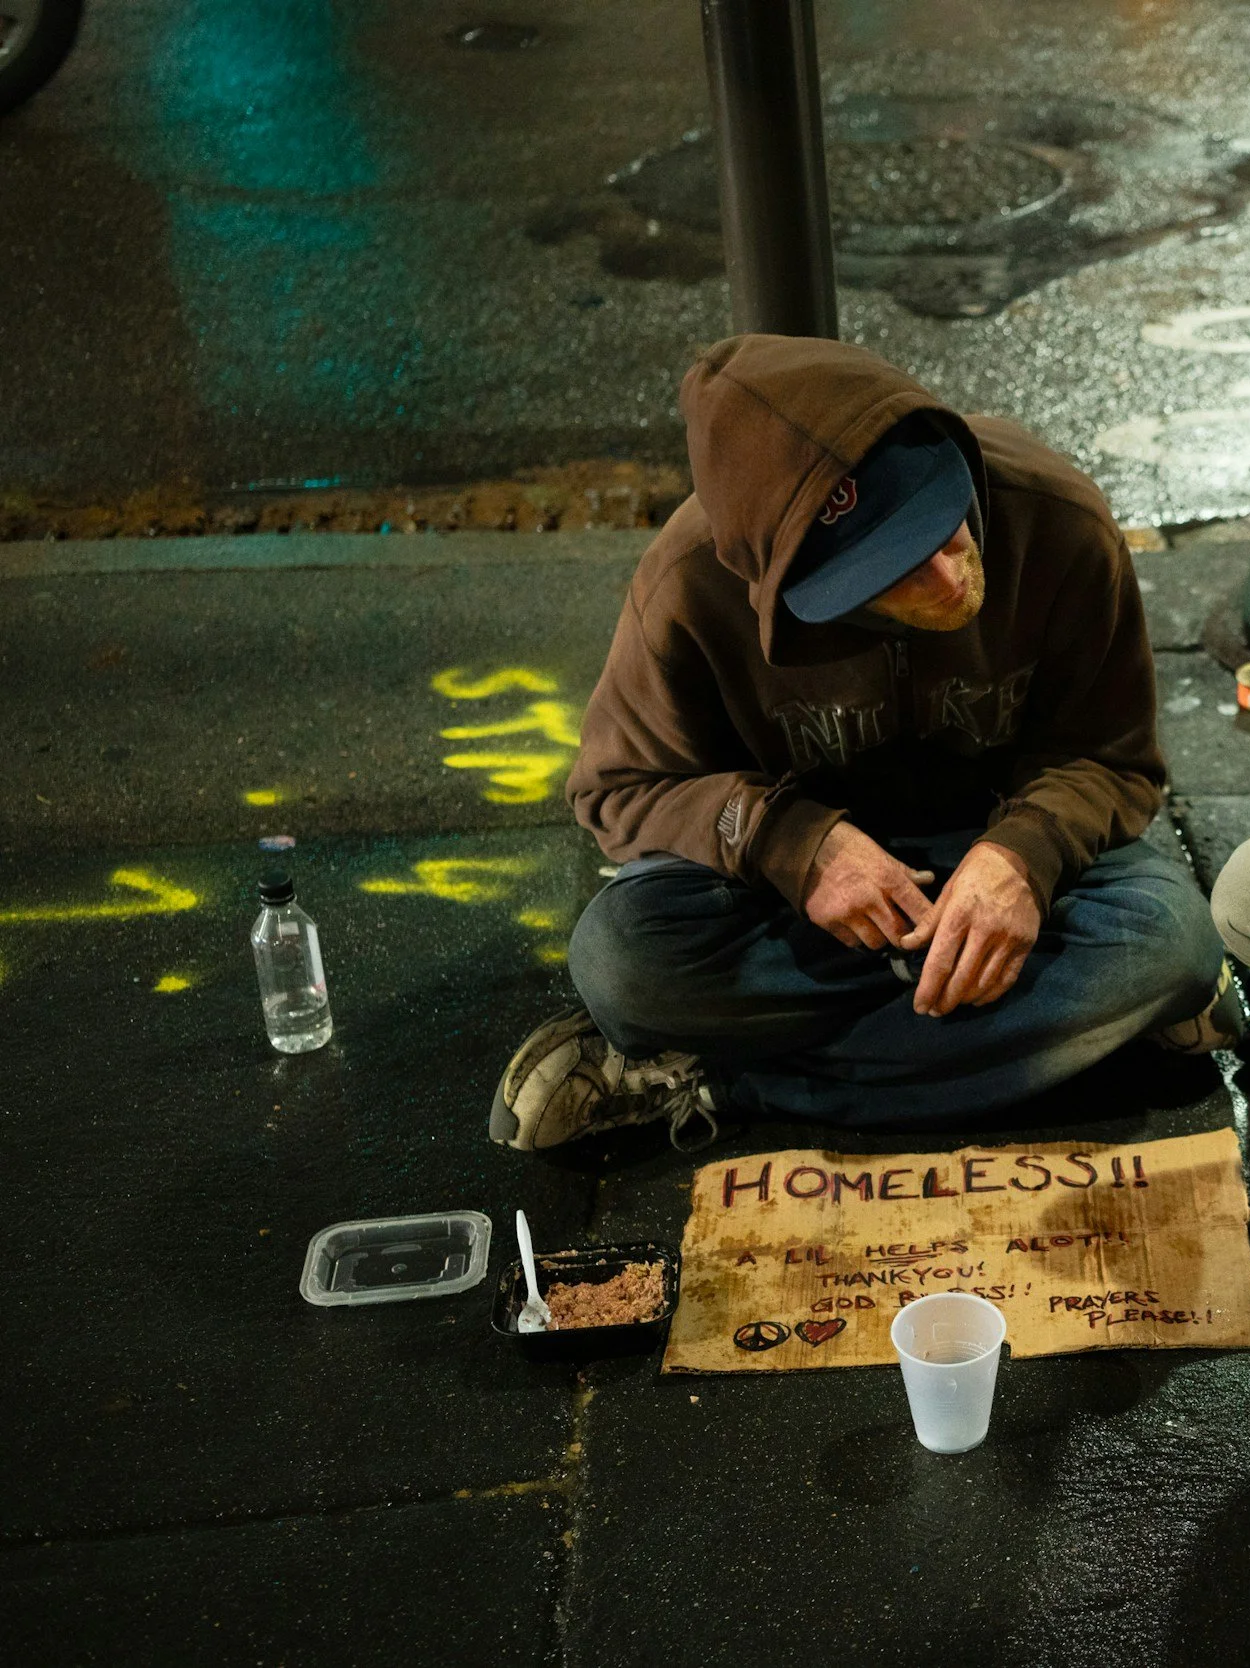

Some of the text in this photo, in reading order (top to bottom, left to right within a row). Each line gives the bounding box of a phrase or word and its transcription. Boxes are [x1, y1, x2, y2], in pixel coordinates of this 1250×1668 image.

[722, 1152, 1149, 1208] HOMELESS!!
[736, 1251, 757, 1266] A
[785, 1245, 834, 1265] LIL
[865, 1240, 969, 1261] HELPS
[810, 1295, 876, 1313] GOD
[1049, 1290, 1160, 1313] PRAYERS
